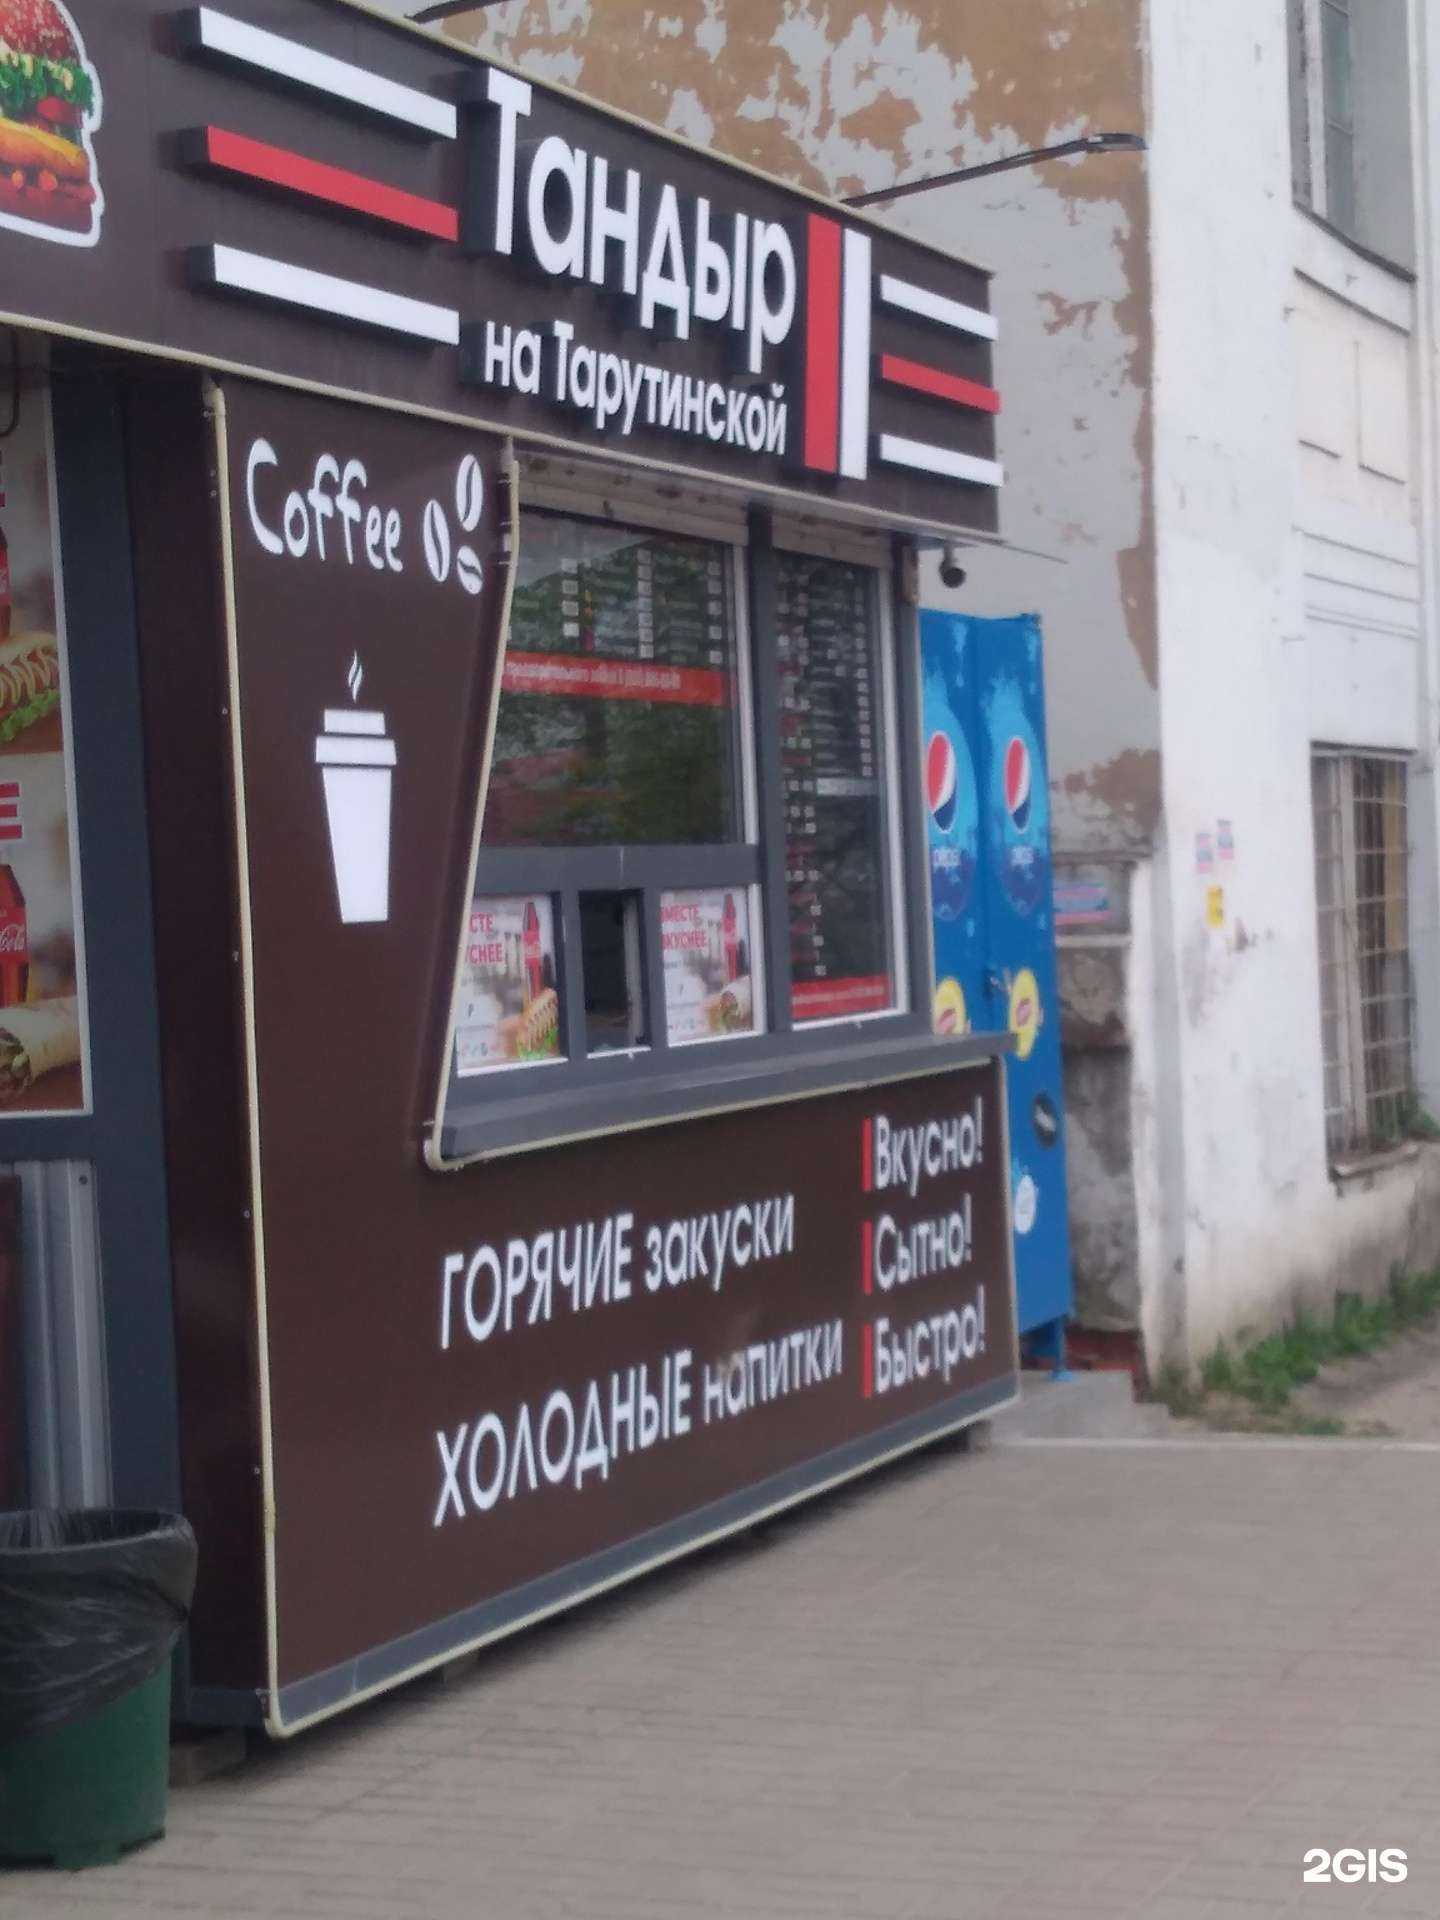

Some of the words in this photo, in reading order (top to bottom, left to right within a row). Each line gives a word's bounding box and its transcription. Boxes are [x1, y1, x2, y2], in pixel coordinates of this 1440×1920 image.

[487, 66, 797, 374] Тандыр
[484, 320, 542, 394] на
[554, 319, 788, 456] Тарутинской
[246, 437, 404, 573] Coffee
[874, 1096, 984, 1198] Вкусно!
[439, 1212, 635, 1351] ГОРЯЧИЕ
[643, 1193, 796, 1293] закуски
[873, 1193, 972, 1291] Сытно!
[873, 1284, 986, 1396] Быстро!
[432, 1348, 693, 1529] ХОЛОДНЫЕ
[703, 1318, 844, 1425] напитки
